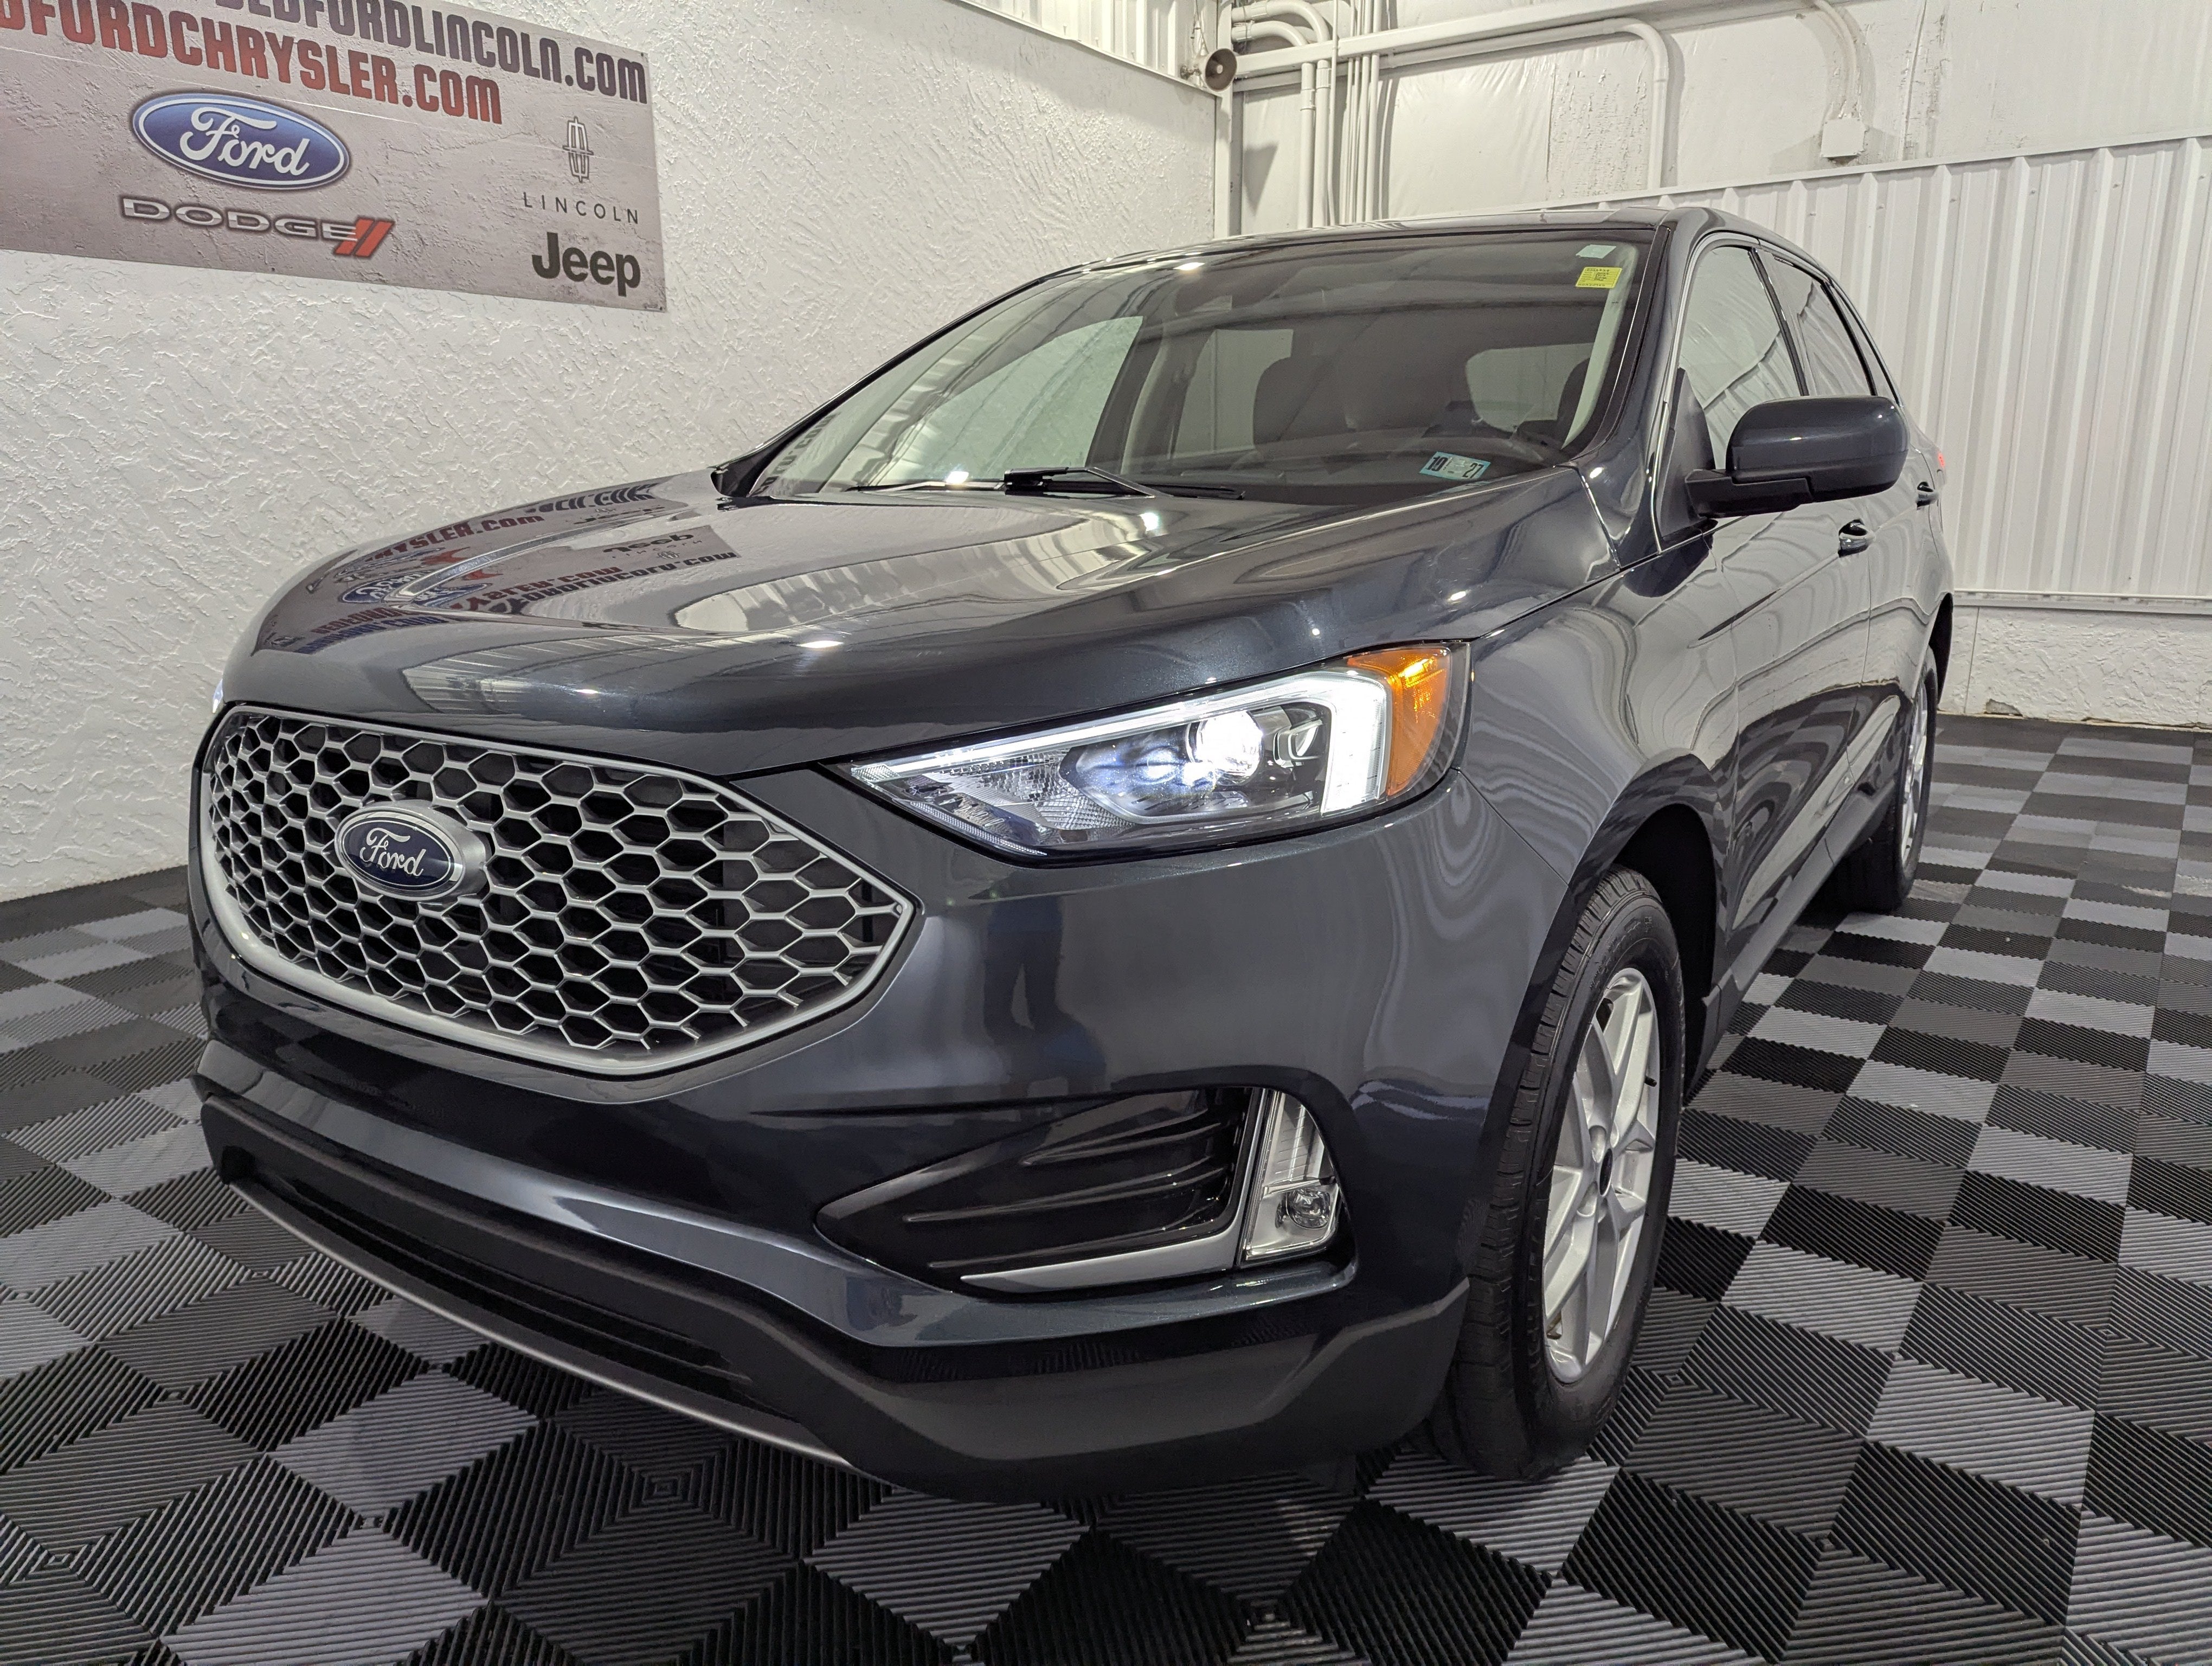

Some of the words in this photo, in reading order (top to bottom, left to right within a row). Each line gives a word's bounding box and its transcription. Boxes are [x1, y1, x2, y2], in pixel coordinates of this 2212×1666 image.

[179, 107, 310, 176] Ford
[123, 198, 358, 242] DODGE
[523, 191, 638, 225] LINCOLN
[531, 232, 641, 298] Jeep
[1462, 463, 1484, 479] 27
[359, 827, 427, 877] Ford
